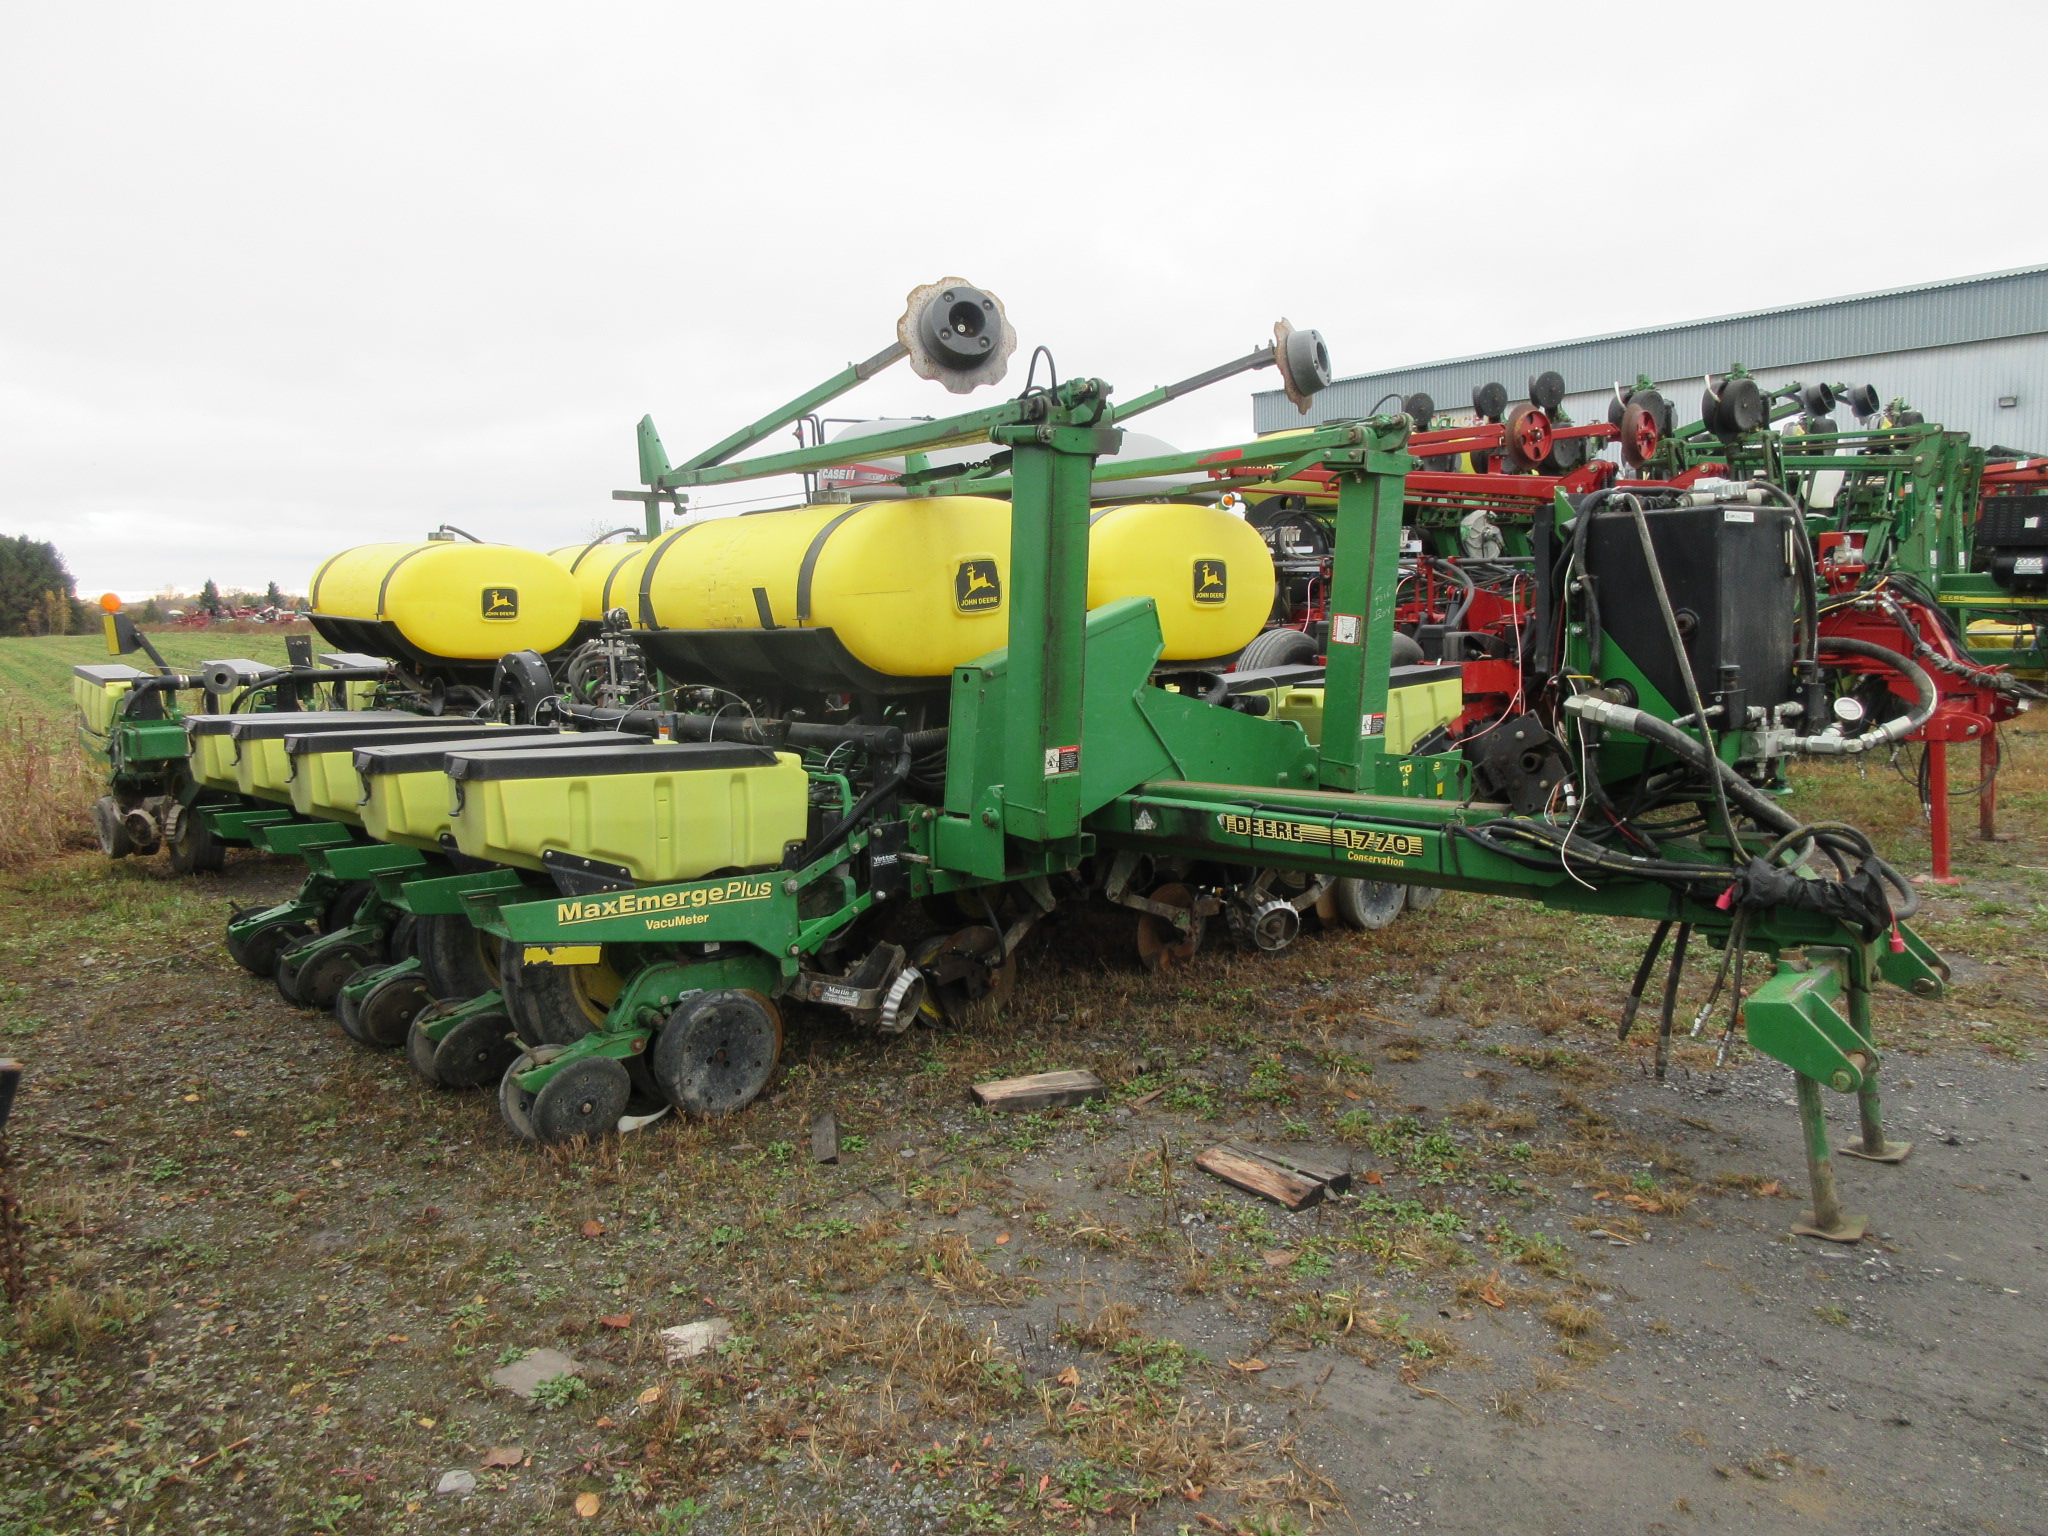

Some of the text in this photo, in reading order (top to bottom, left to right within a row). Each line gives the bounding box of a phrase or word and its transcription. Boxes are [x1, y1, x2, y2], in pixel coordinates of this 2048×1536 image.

[822, 469, 845, 479] CASE
[1235, 817, 1302, 842] DEERE
[1344, 829, 1411, 855] 1770
[1347, 851, 1404, 867] Conservation
[646, 913, 709, 930] VacuMeter
